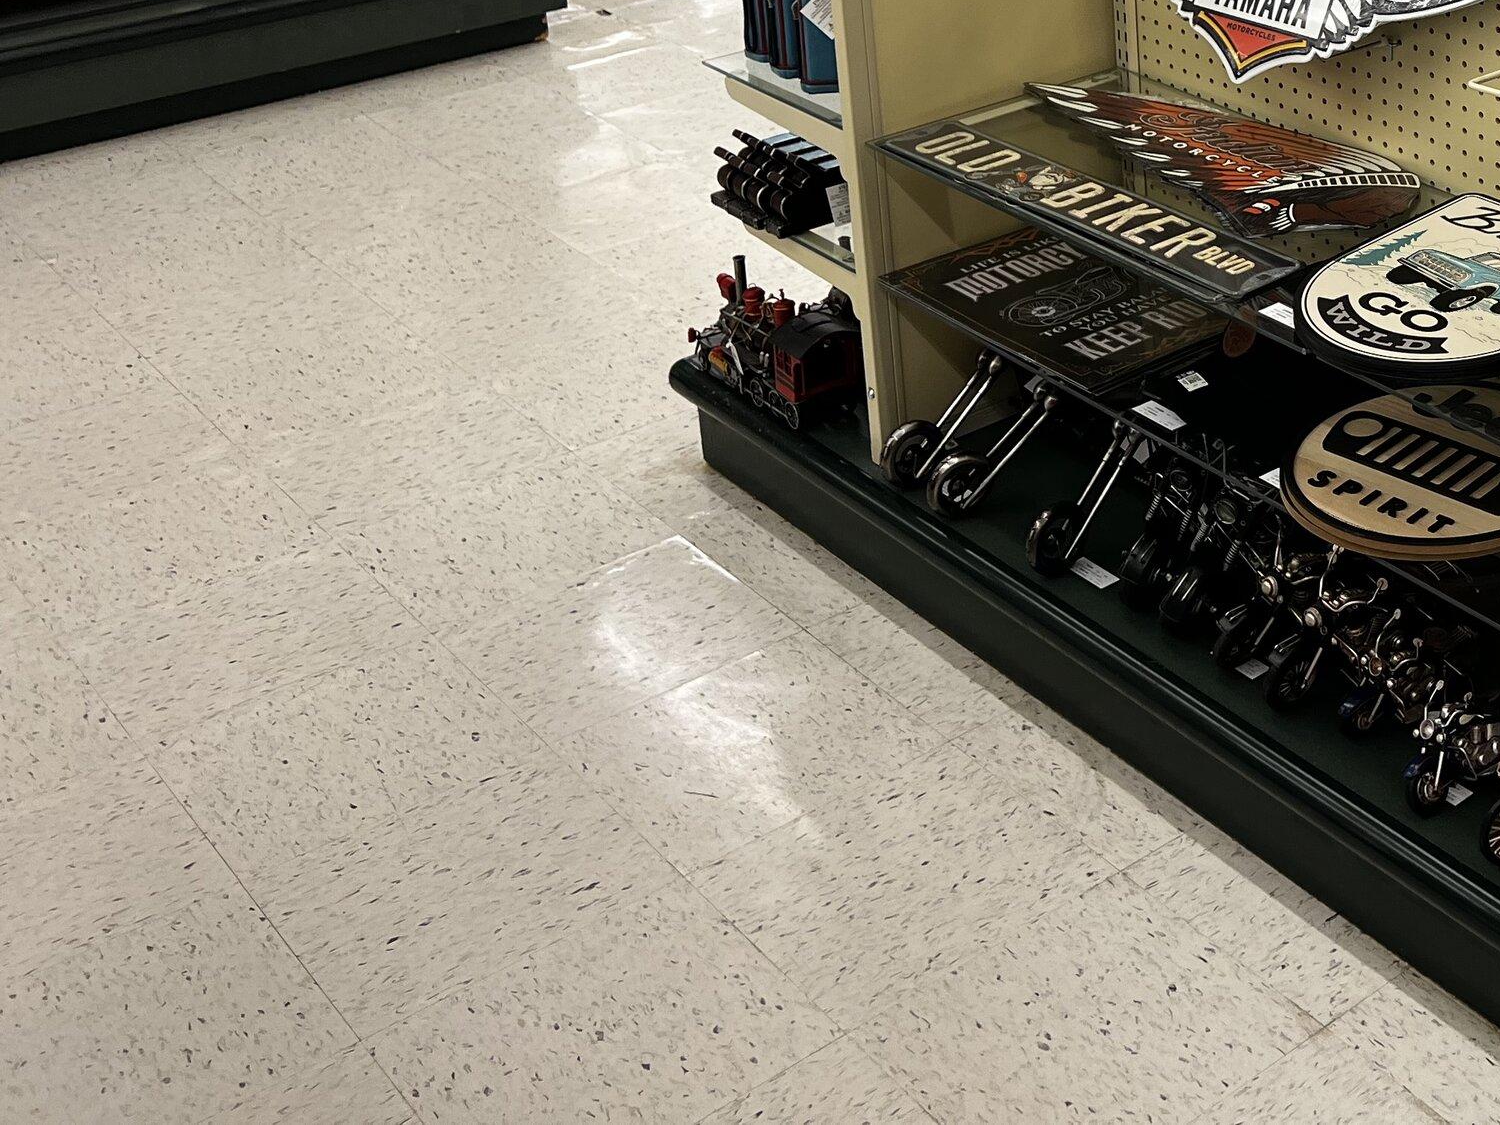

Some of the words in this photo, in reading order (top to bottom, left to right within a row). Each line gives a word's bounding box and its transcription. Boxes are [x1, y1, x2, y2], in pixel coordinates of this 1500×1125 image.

[1226, 22, 1277, 42] MOTORCYCLES
[913, 130, 1020, 176] OLD
[1041, 182, 1217, 260] BIKER
[1192, 245, 1257, 276] BLVD
[1325, 301, 1431, 352] WILD
[1358, 291, 1450, 333] GO
[1307, 470, 1457, 533] SPIRIT
